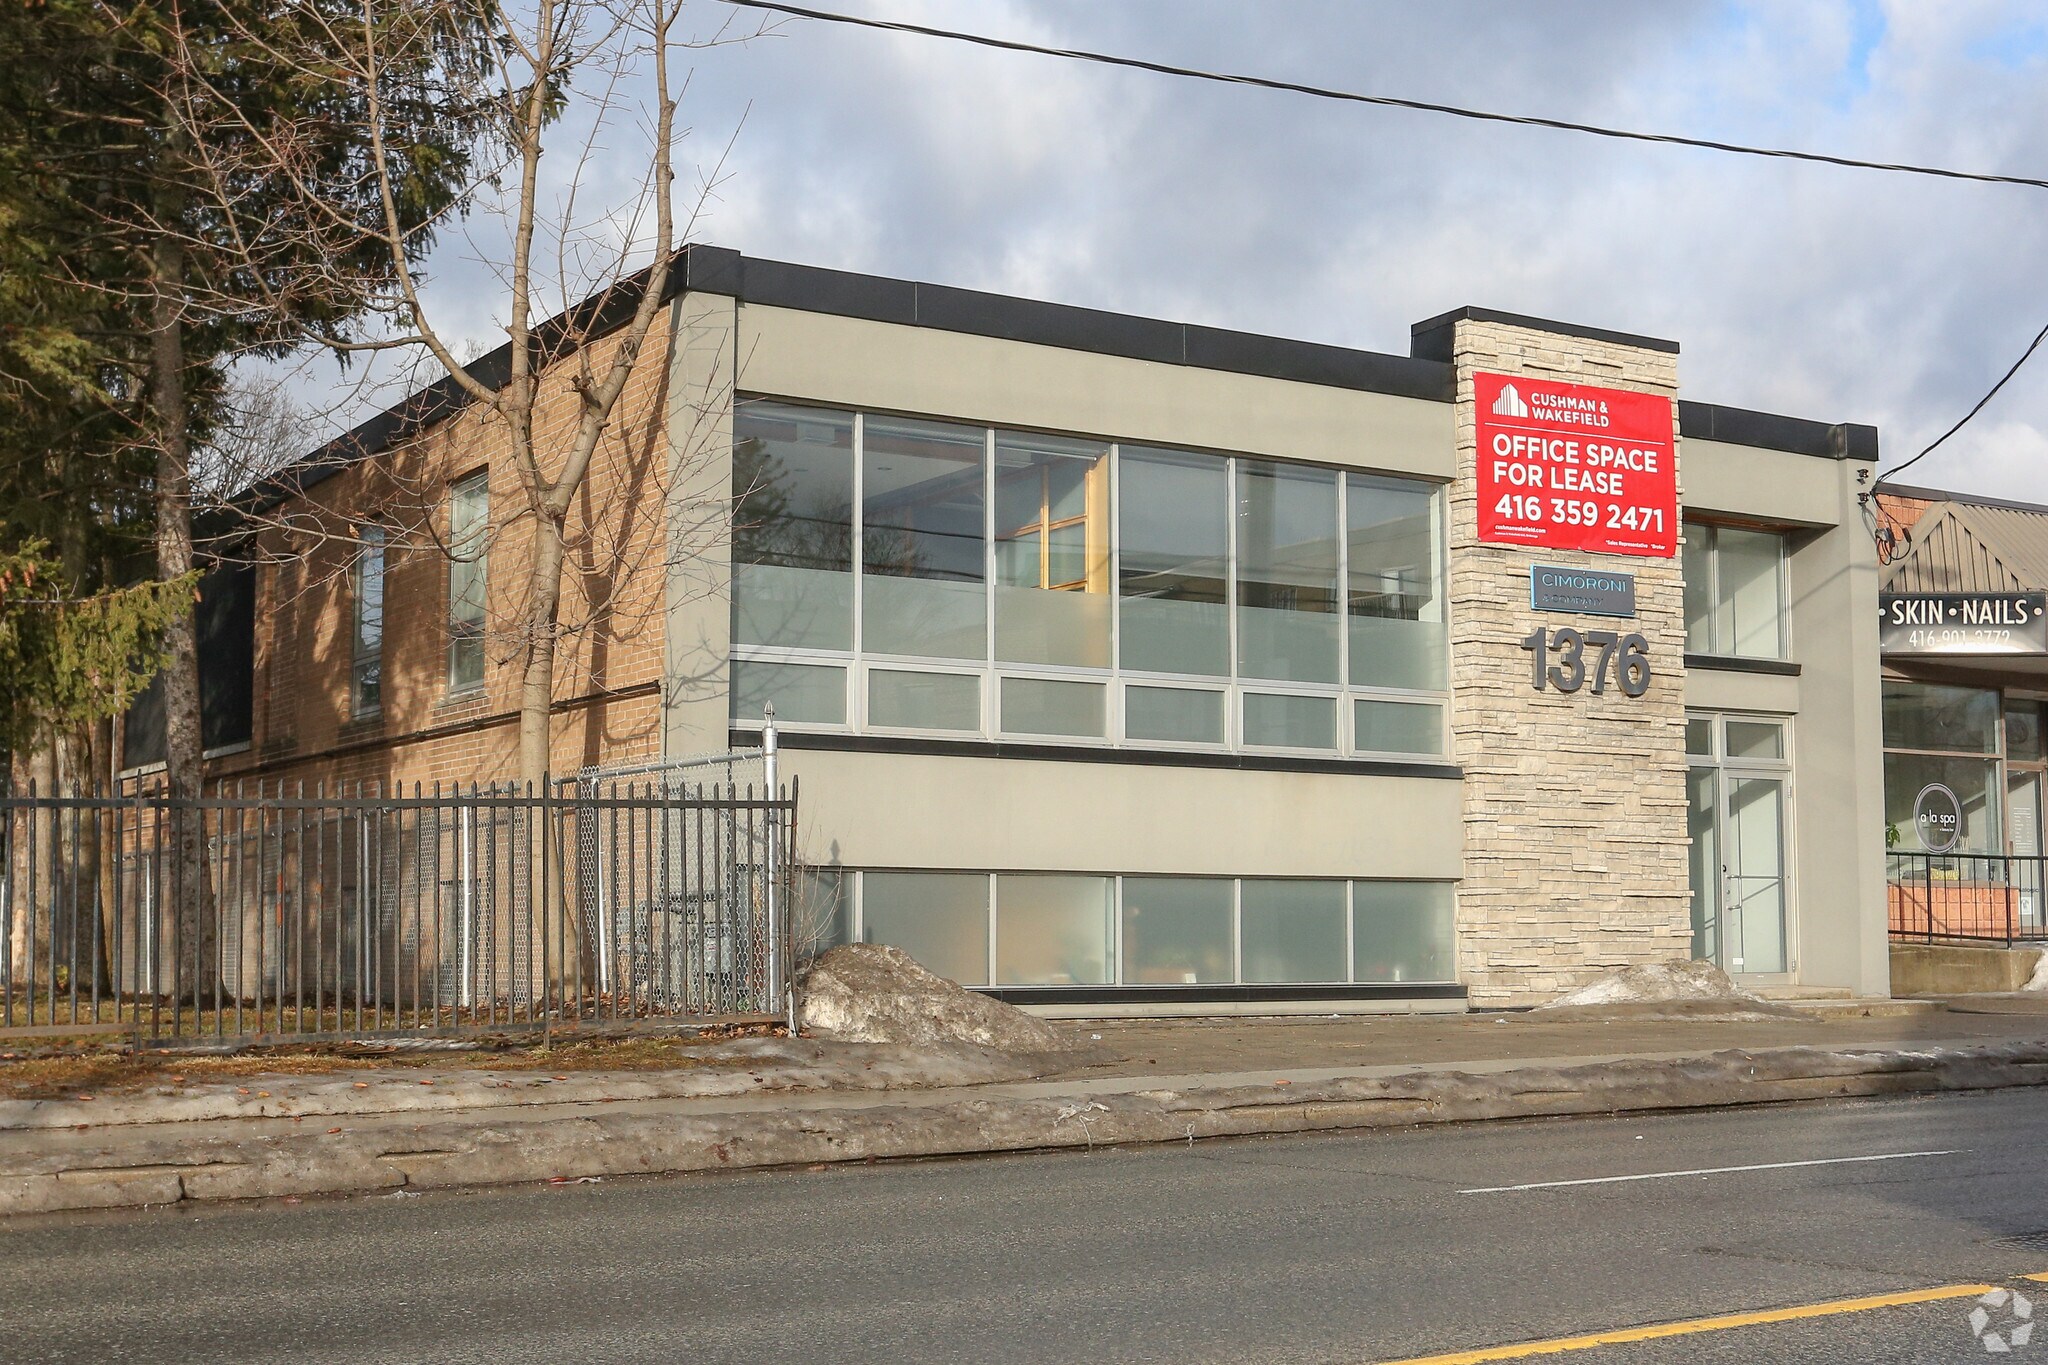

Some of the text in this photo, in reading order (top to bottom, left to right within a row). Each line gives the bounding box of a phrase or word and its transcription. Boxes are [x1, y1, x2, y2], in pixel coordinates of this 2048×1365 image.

[1531, 393, 1609, 414] CUSHMAN &
[1532, 407, 1609, 427] WAKEFIELD
[1493, 433, 1658, 473] OFFICE SPACE
[1493, 461, 1624, 496] FOR LEASE
[1494, 494, 1663, 532] 416 359 2471
[1542, 573, 1626, 593] CIMORONI
[1551, 594, 1604, 606] COMPANY
[1891, 599, 2028, 625] SKIN NAILS
[1521, 627, 1650, 697] 1376
[1940, 814, 1956, 827] spa
